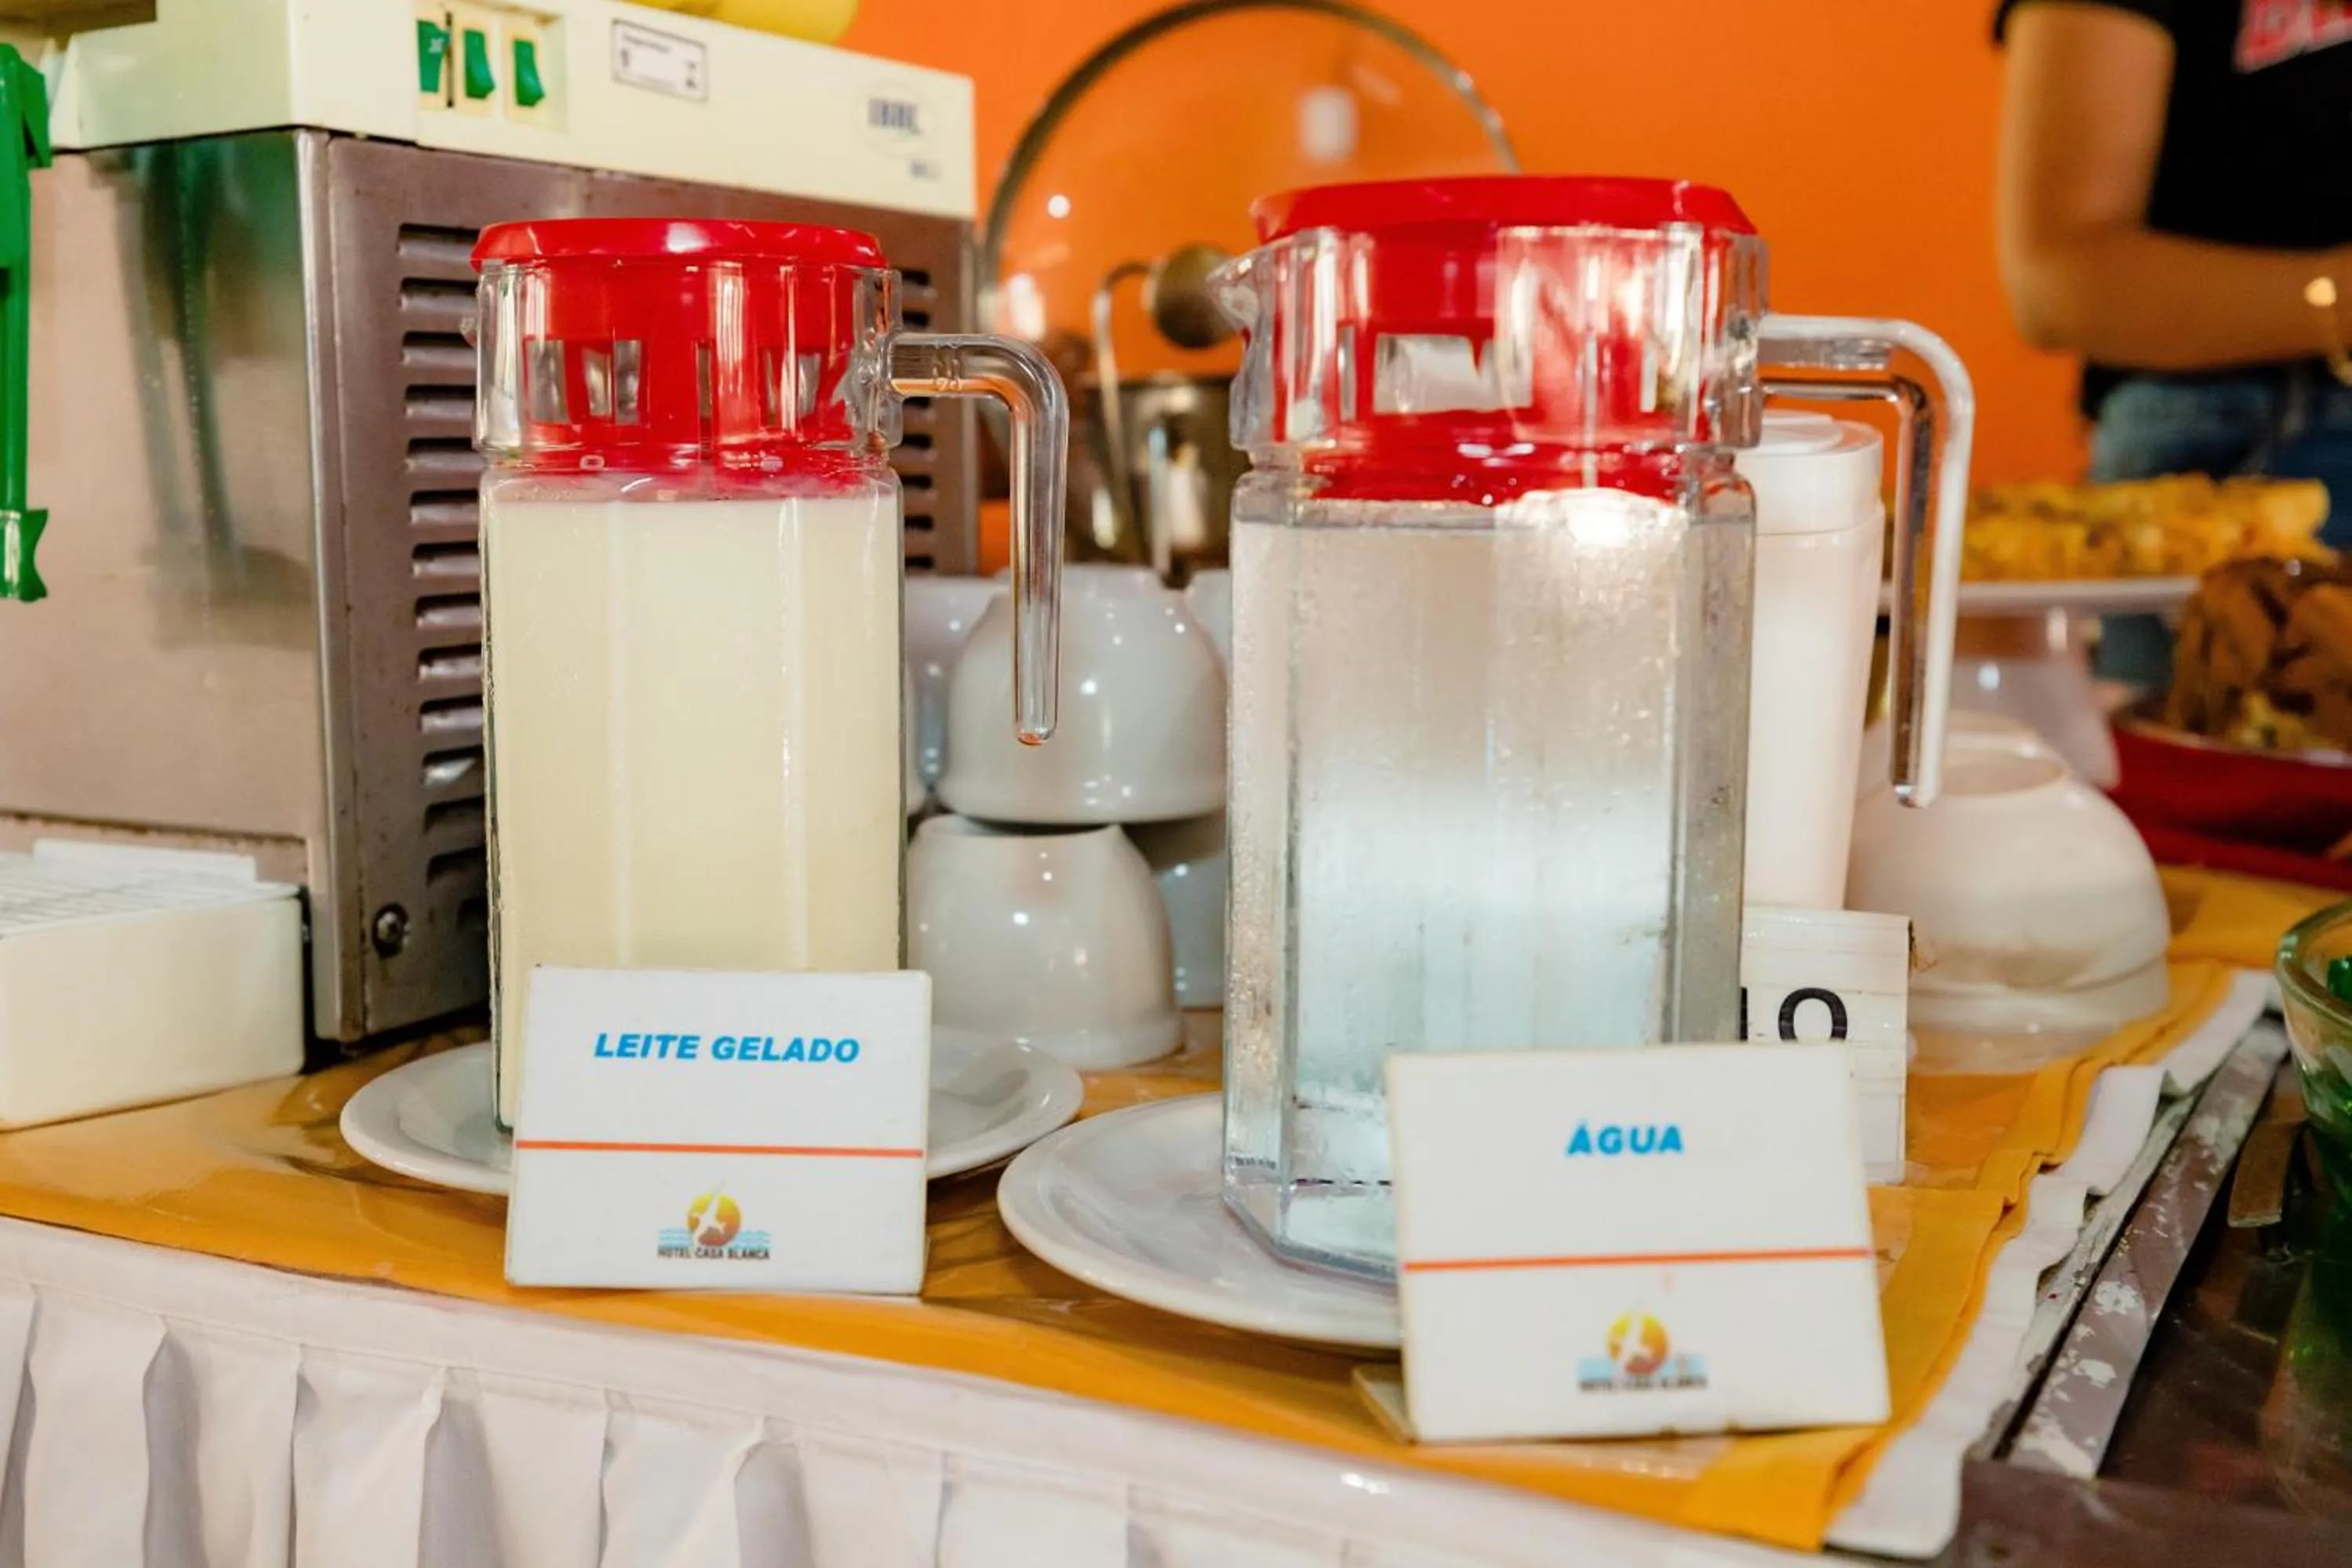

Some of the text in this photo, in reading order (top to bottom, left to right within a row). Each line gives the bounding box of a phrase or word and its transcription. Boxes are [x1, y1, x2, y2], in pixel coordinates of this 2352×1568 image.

[593, 1033, 861, 1064] LEITE GELADO
[1566, 1119, 1684, 1156] ÁGUA
